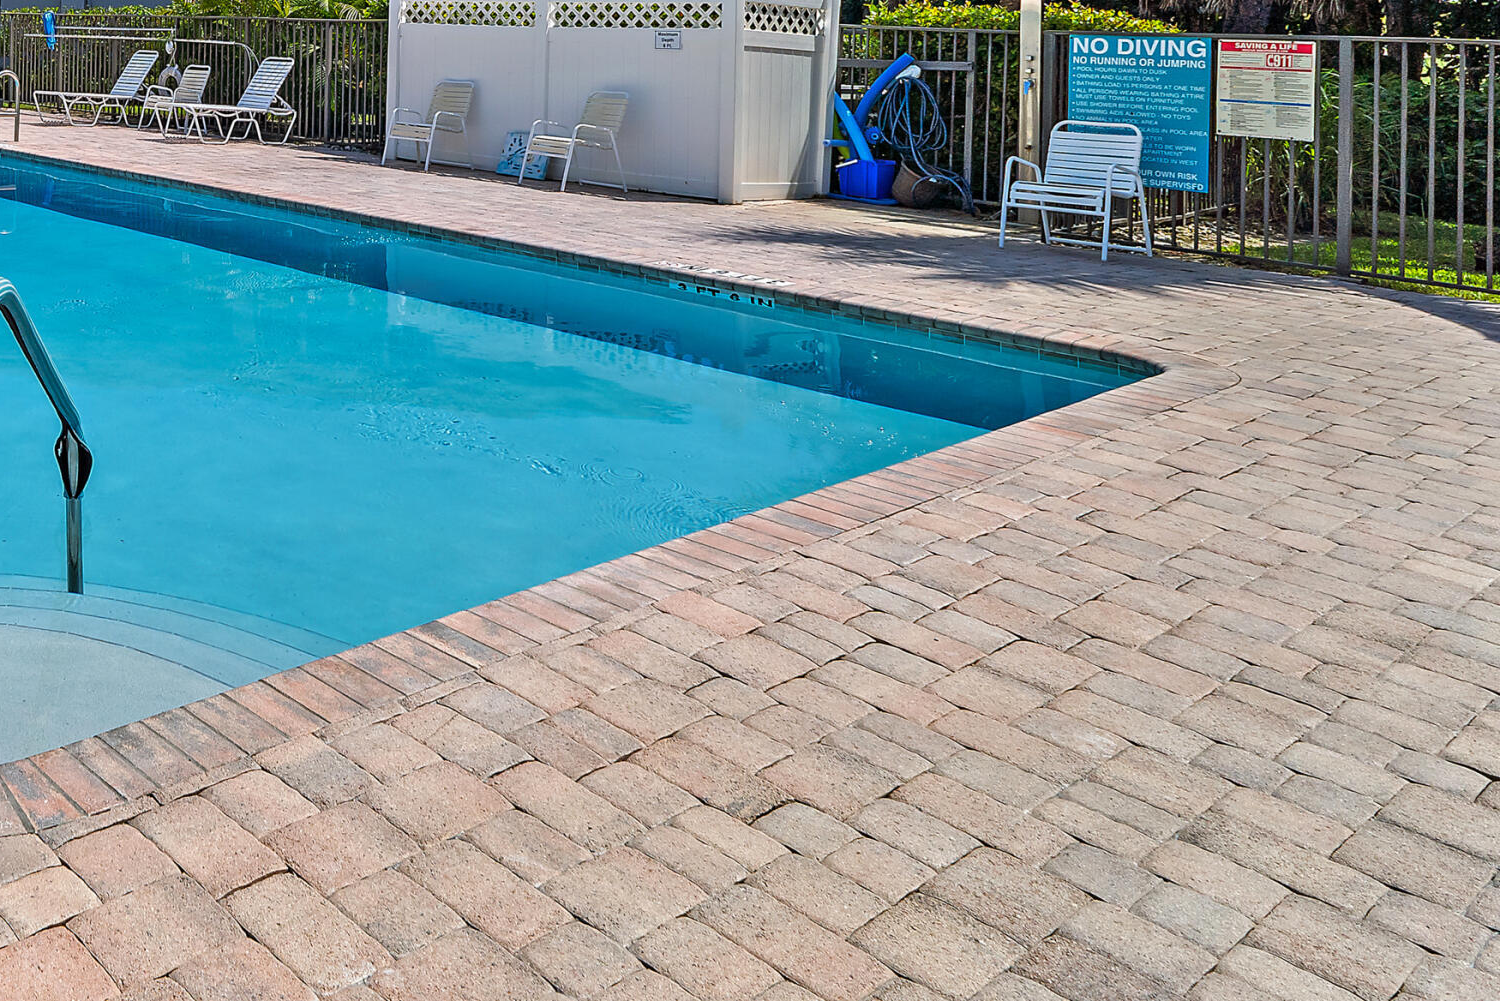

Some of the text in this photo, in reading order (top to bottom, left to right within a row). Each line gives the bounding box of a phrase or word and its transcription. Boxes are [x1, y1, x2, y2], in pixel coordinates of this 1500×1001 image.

[1073, 37, 1206, 58] NO DIVING
[1234, 42, 1269, 50] SAVING
[1278, 43, 1298, 51] LIFE
[1073, 56, 1206, 69] NO RUNNING OR JUMPING
[1142, 149, 1183, 157] APARTMENT
[1154, 170, 1175, 179] OWN
[1177, 172, 1198, 181] RISK
[1150, 179, 1204, 190] SUPERVISED
[750, 296, 773, 308] IN
